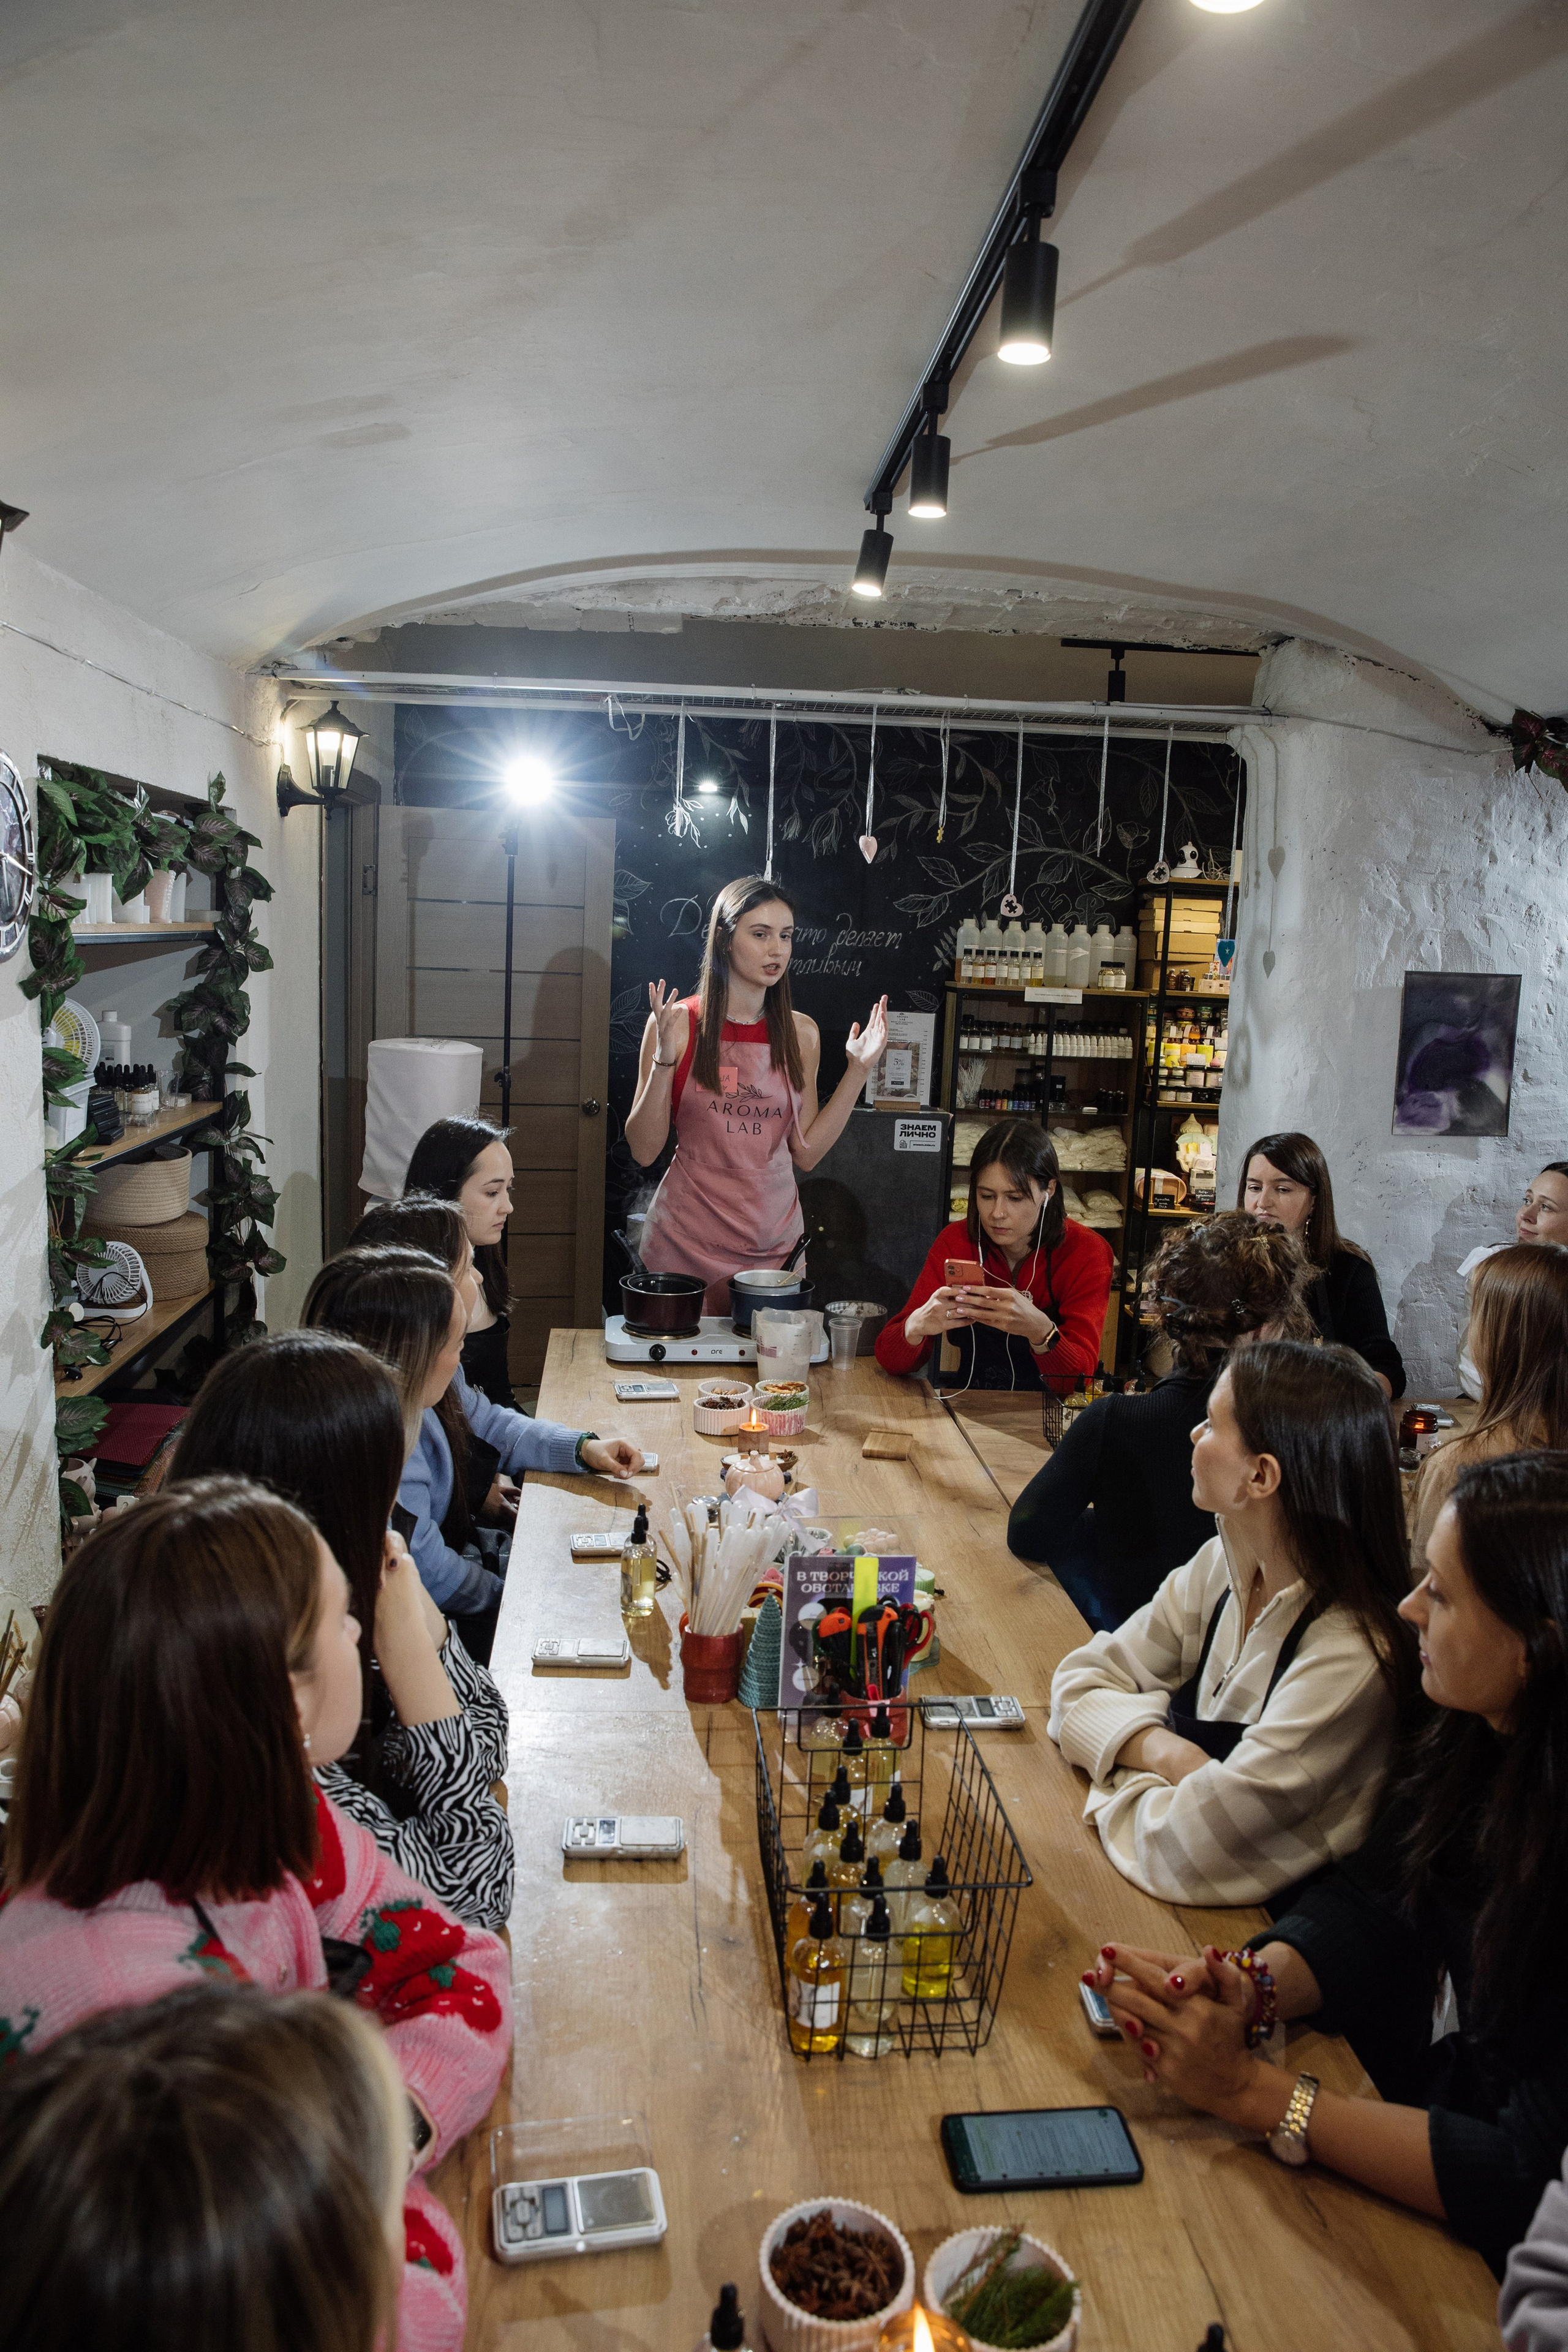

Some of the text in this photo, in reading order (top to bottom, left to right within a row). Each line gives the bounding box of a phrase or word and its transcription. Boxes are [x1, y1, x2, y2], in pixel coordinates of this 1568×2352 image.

[795, 912, 903, 950] что делает
[788, 941, 863, 977] тливым
[893, 1058, 905, 1066] 5%
[706, 1100, 782, 1119] AROMA
[726, 1120, 762, 1136] LAB
[797, 1569, 910, 1581] В ТВОРКОЙ
[801, 1583, 900, 1593] ОБСТАКЕ
